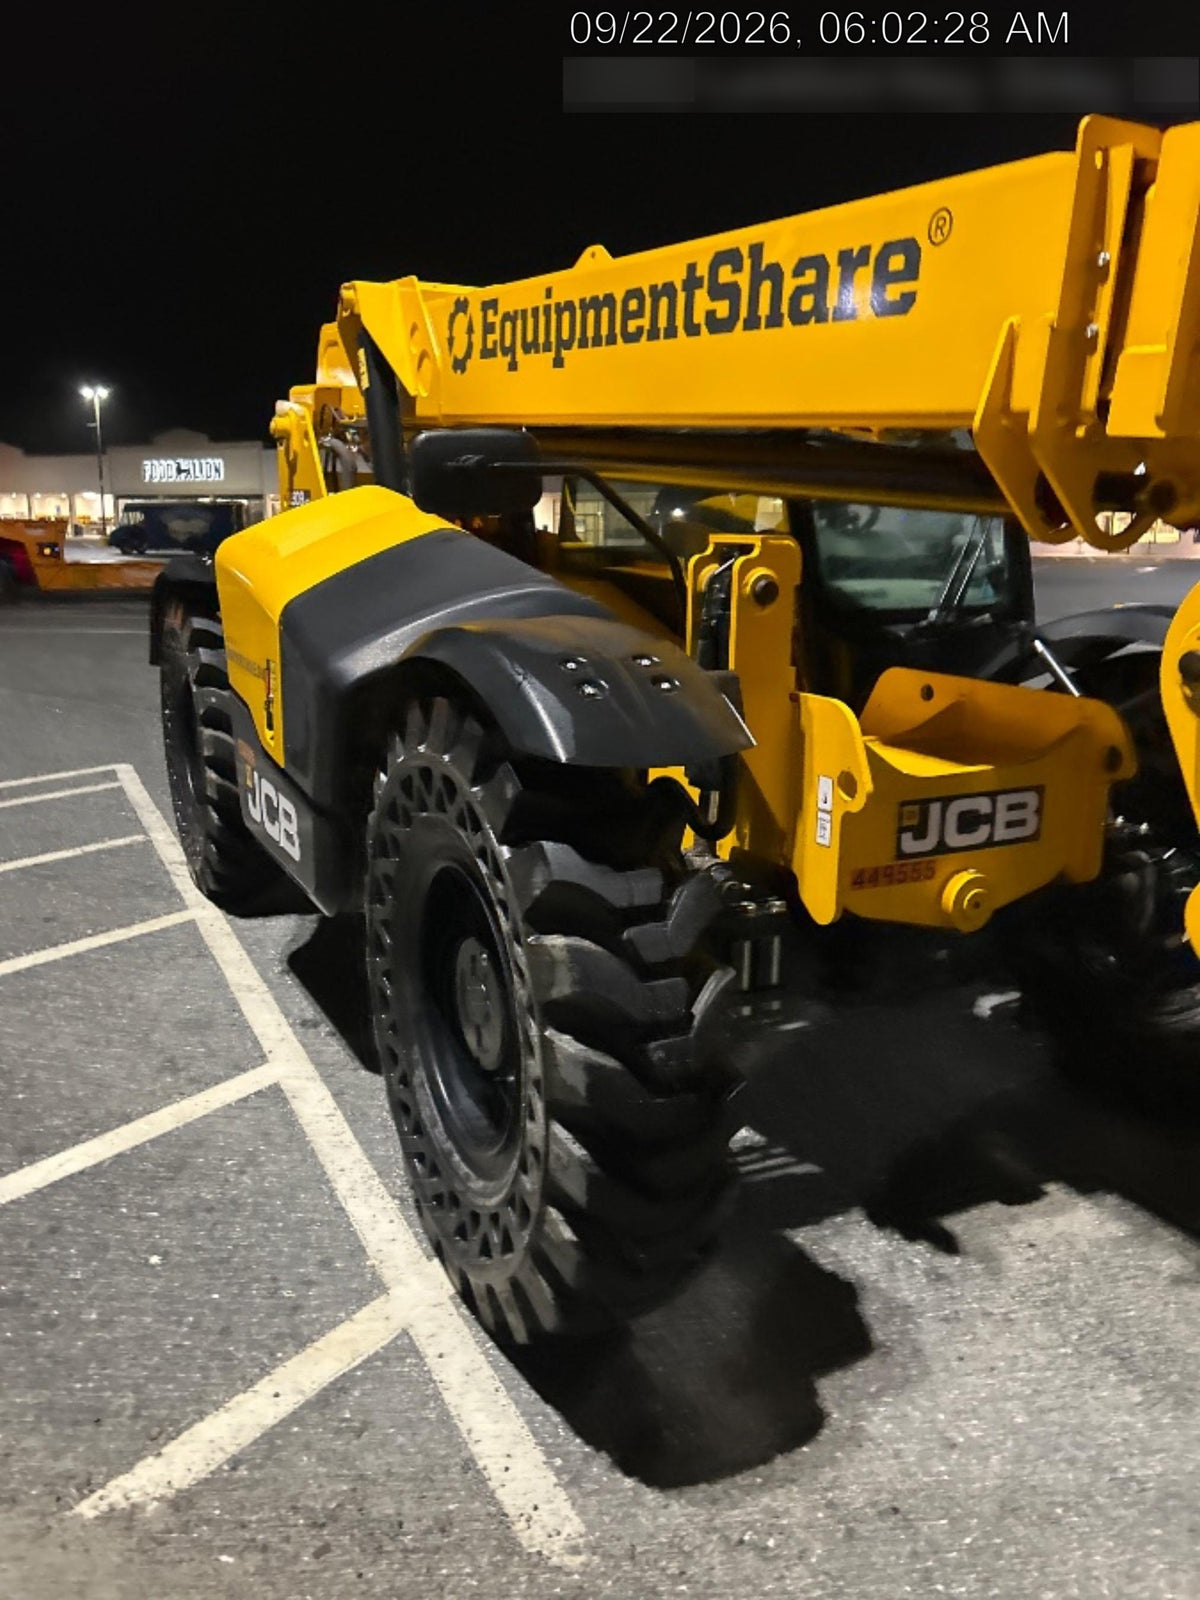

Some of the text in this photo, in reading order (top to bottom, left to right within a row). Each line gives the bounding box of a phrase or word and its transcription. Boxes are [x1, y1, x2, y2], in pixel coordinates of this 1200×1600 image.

[479, 236, 922, 372] EquipmentShare
[143, 458, 224, 482] FOOD LION
[248, 771, 301, 862] JCB
[901, 790, 1040, 854] JCB
